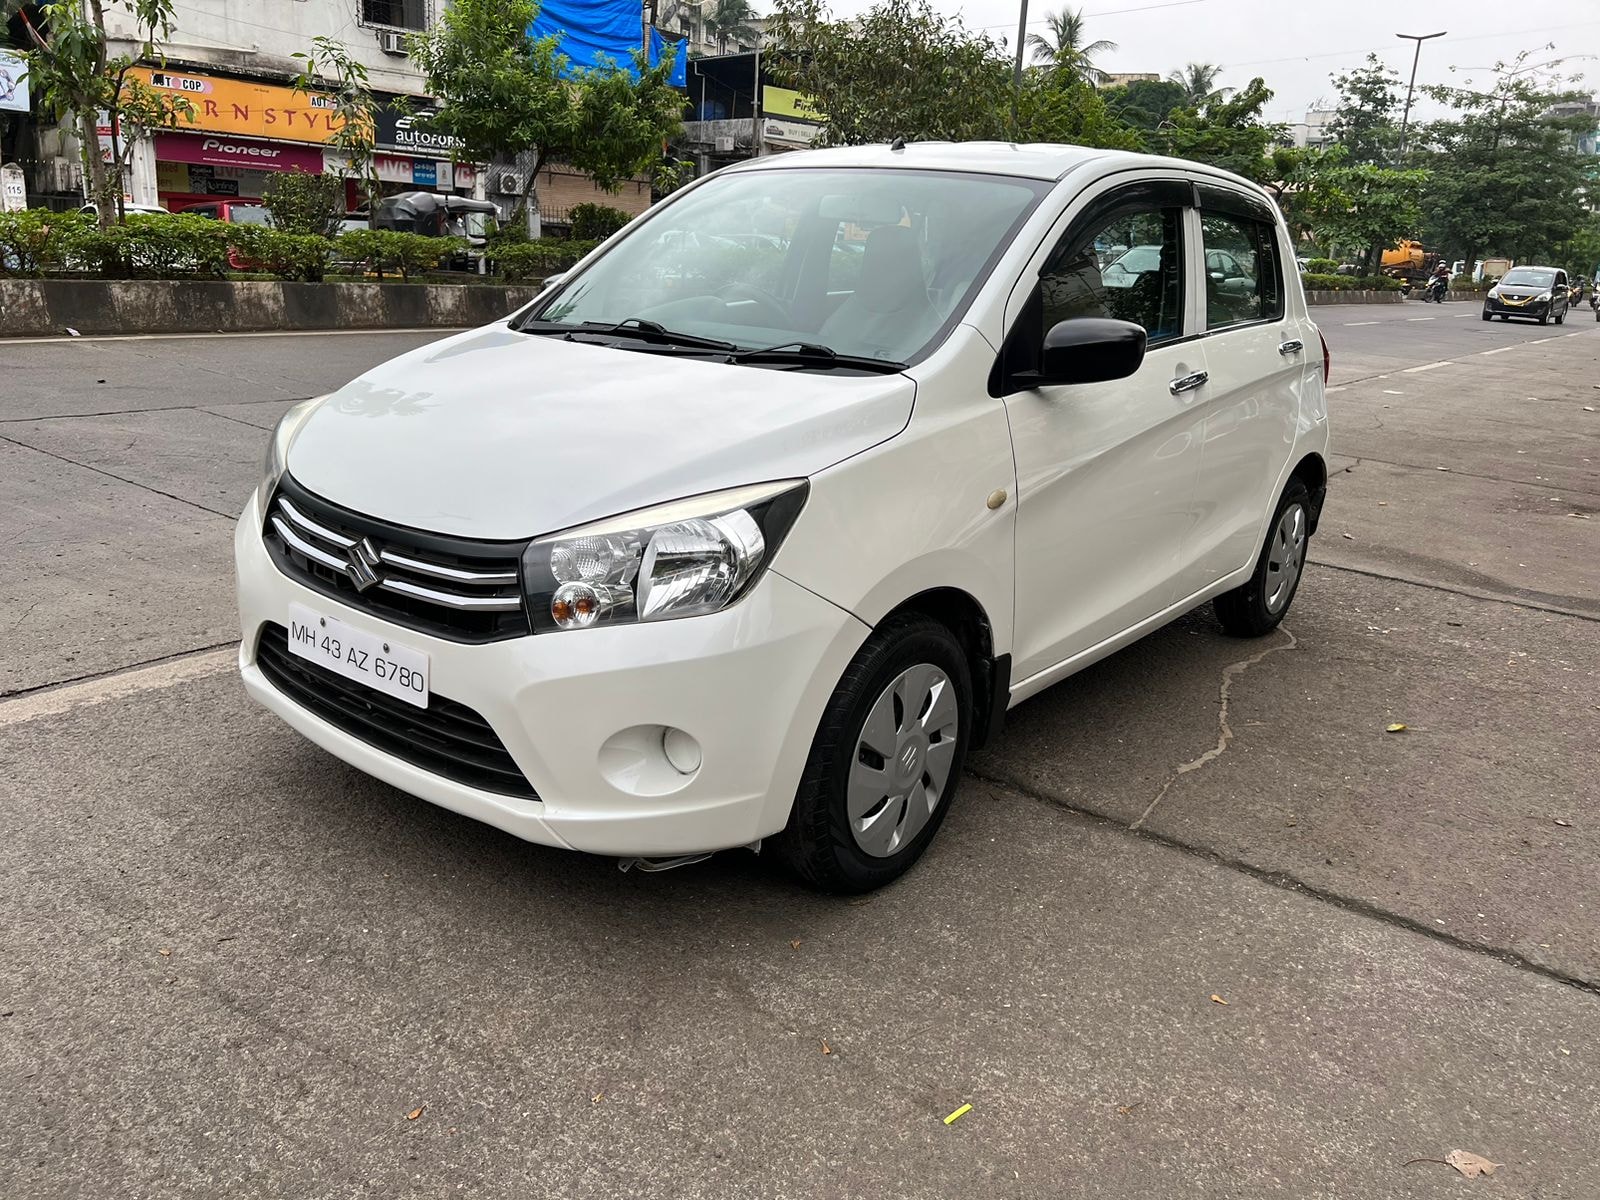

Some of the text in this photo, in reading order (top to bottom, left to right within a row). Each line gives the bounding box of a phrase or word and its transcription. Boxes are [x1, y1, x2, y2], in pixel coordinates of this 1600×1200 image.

[183, 79, 201, 91] COP
[265, 108, 346, 130] STYL
[202, 139, 281, 158] Pioneer
[379, 160, 410, 177] JVC
[7, 186, 22, 195] 115
[292, 621, 424, 693] MH 43 AZ 6780
